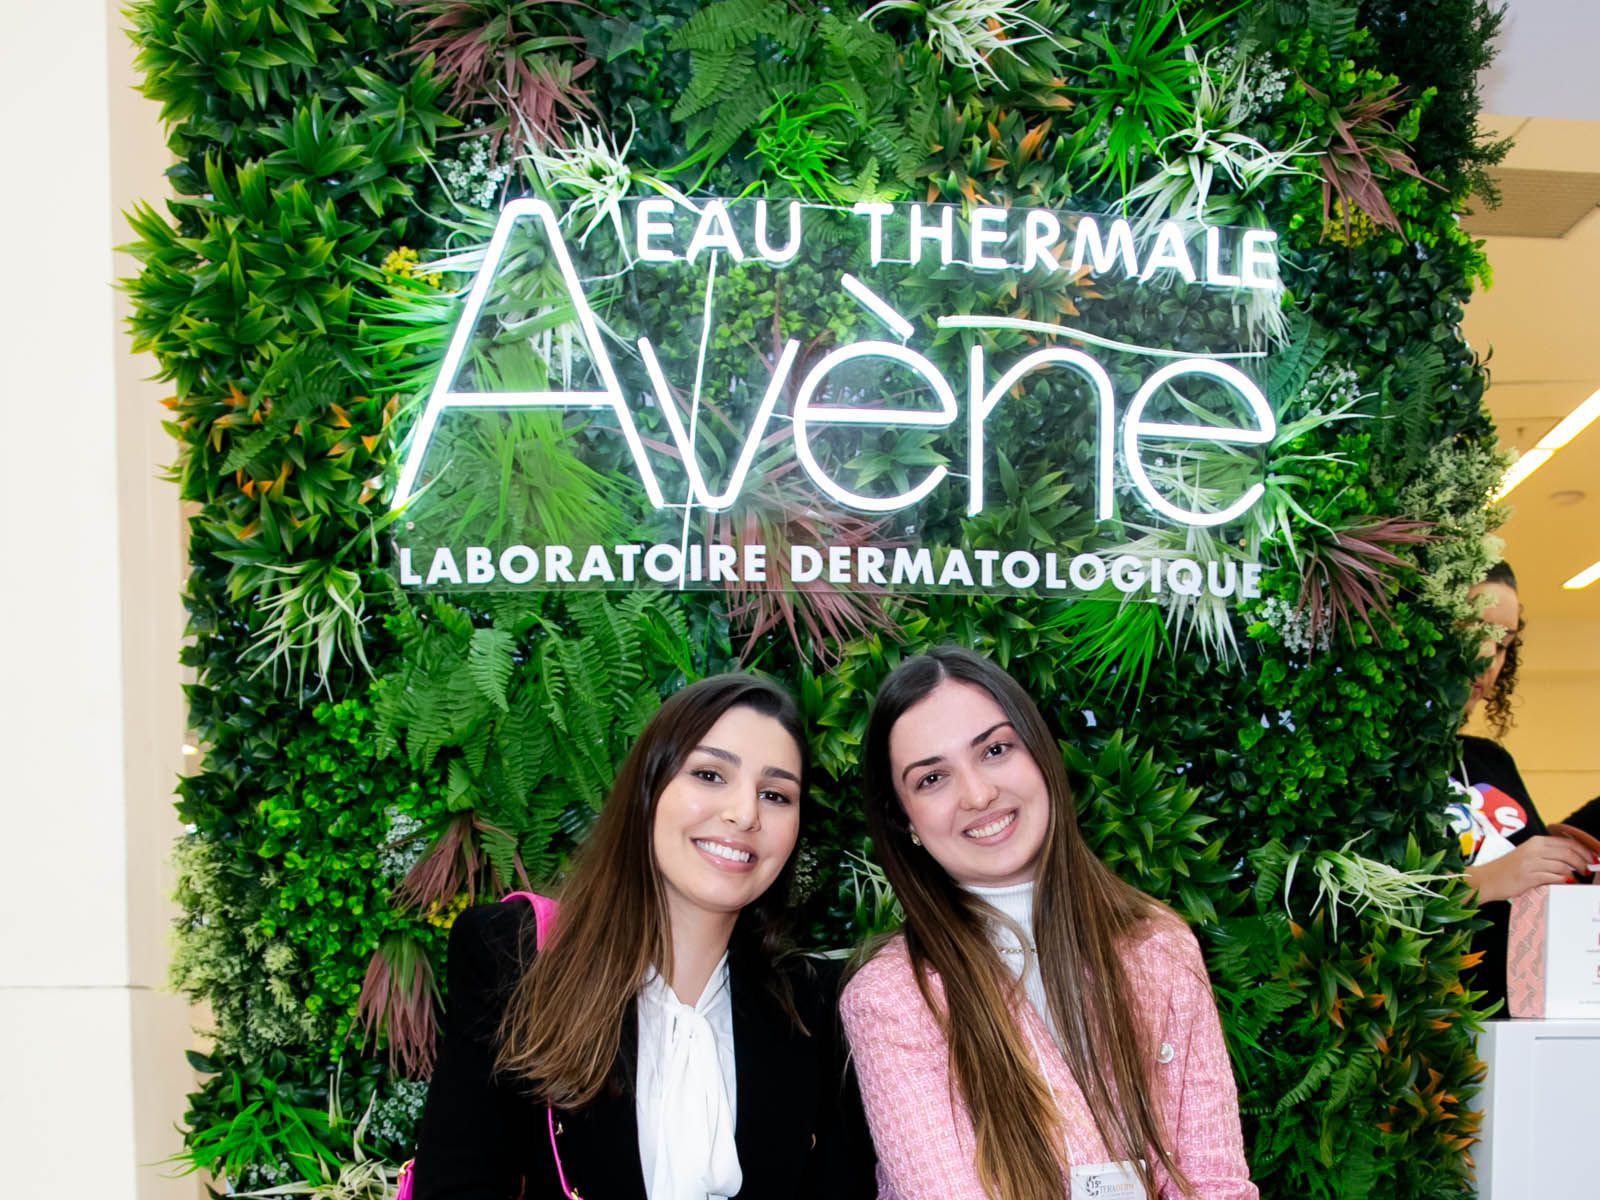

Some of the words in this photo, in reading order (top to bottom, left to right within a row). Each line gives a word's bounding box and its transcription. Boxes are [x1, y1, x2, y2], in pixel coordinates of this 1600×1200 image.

[635, 199, 801, 264] EAU
[854, 201, 1280, 291] THERMALE
[396, 198, 1278, 527] Avène
[399, 542, 768, 587] LABORATOIRE
[789, 545, 1263, 601] DERMATOLOGIQUE
